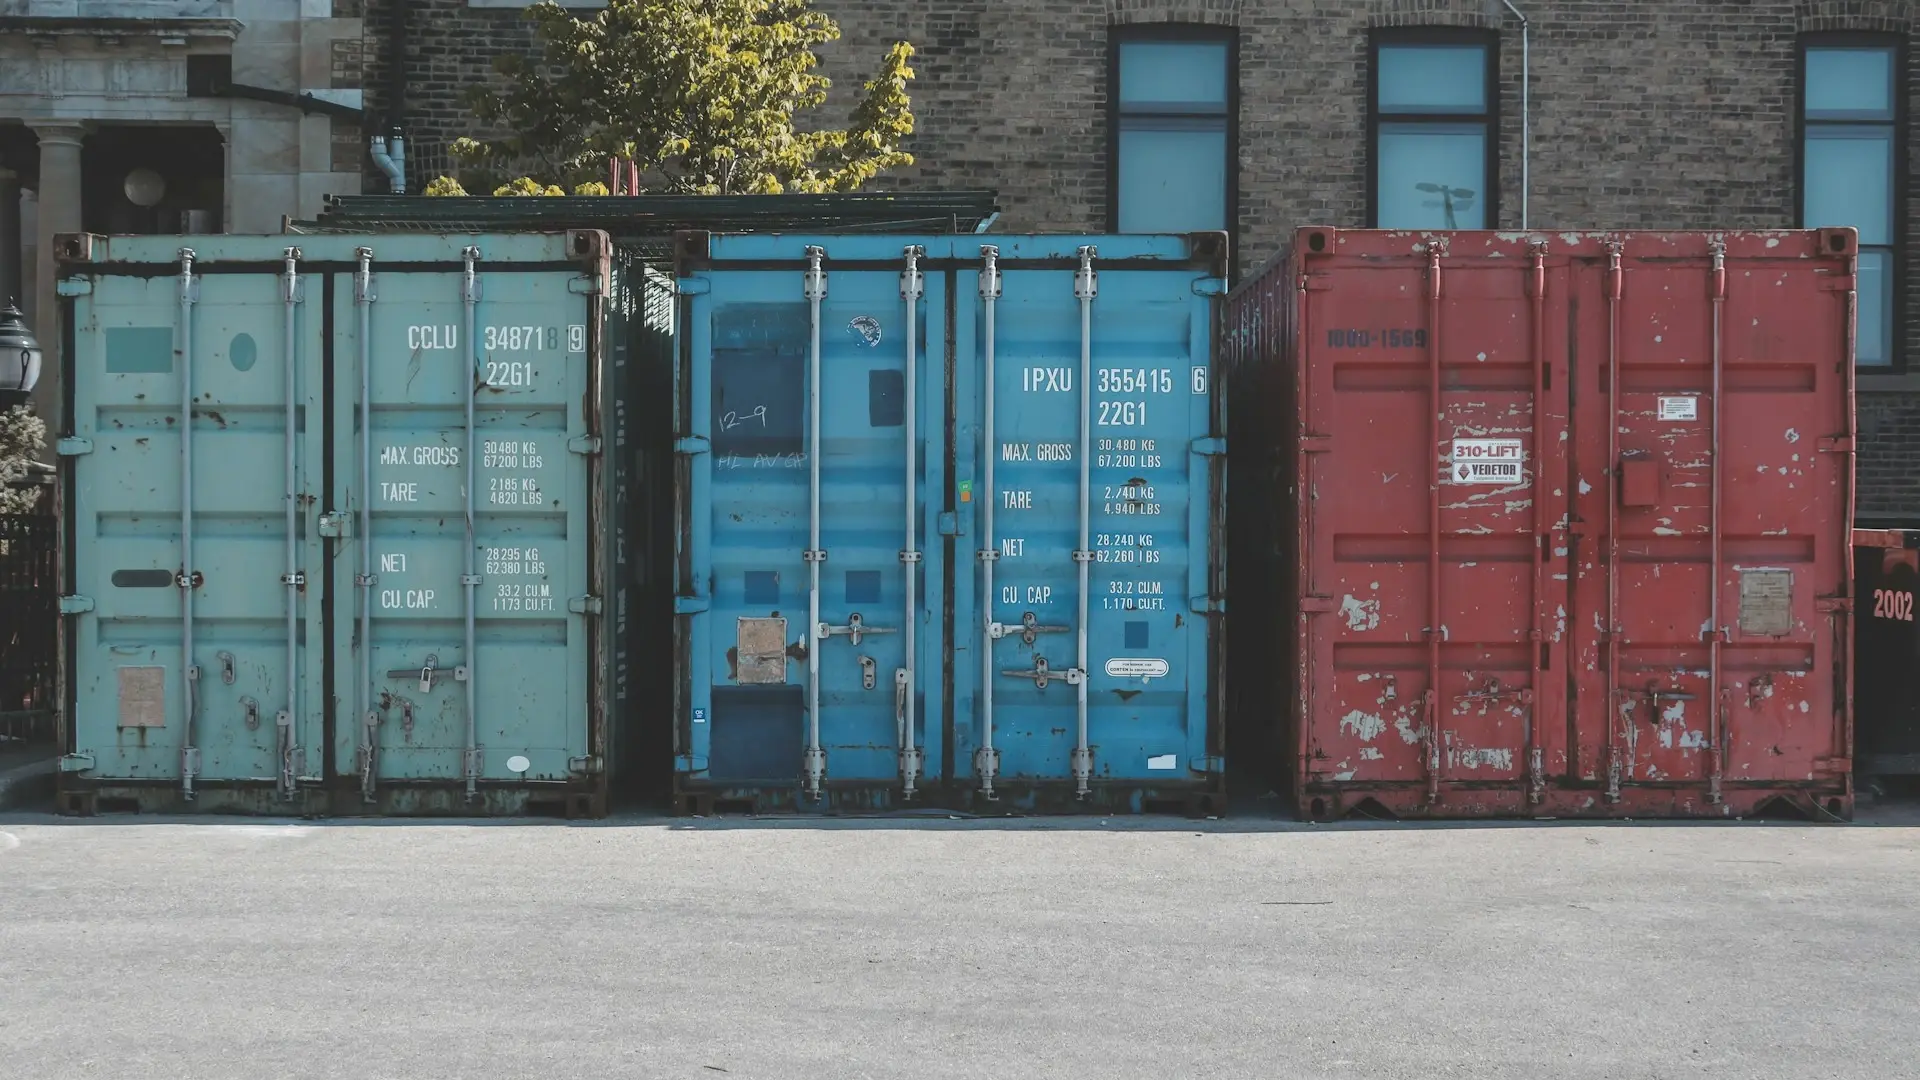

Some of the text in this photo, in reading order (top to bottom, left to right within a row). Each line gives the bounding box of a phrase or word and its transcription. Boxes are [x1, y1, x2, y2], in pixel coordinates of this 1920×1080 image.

[408, 325, 457, 349] CCLU
[570, 326, 583, 351] 9
[486, 362, 530, 385] 22G1
[1023, 367, 1205, 393] IPXU 355415 6
[720, 405, 767, 432] 12-9
[1098, 402, 1145, 425] 22G1
[523, 442, 536, 454] KG
[1142, 440, 1155, 451] KG
[1456, 446, 1519, 457] 310-LIFT
[380, 447, 458, 465] MAX. GROSS
[1003, 444, 1072, 461] MAX. GROSS
[523, 456, 542, 468] LBS
[1141, 455, 1161, 468] LBS
[1472, 465, 1515, 475] VENETOR
[523, 479, 536, 491] KG
[381, 483, 417, 501] TARE
[1141, 487, 1154, 499] KG
[523, 493, 542, 504] LBS
[1003, 491, 1032, 509] TARE
[1140, 504, 1160, 515] LBS
[1140, 535, 1152, 546] KG
[1003, 539, 1024, 556] NET
[525, 549, 538, 561] KG
[525, 562, 545, 574] LBS
[498, 585, 552, 597] 33.2 CU.M.
[1110, 582, 1163, 594] 33.2 CU.M.
[382, 590, 437, 609] CU. CAP.
[1003, 586, 1053, 604] CU. CAP.
[525, 599, 555, 611] CU.FT.
[1874, 589, 1913, 621] 2002
